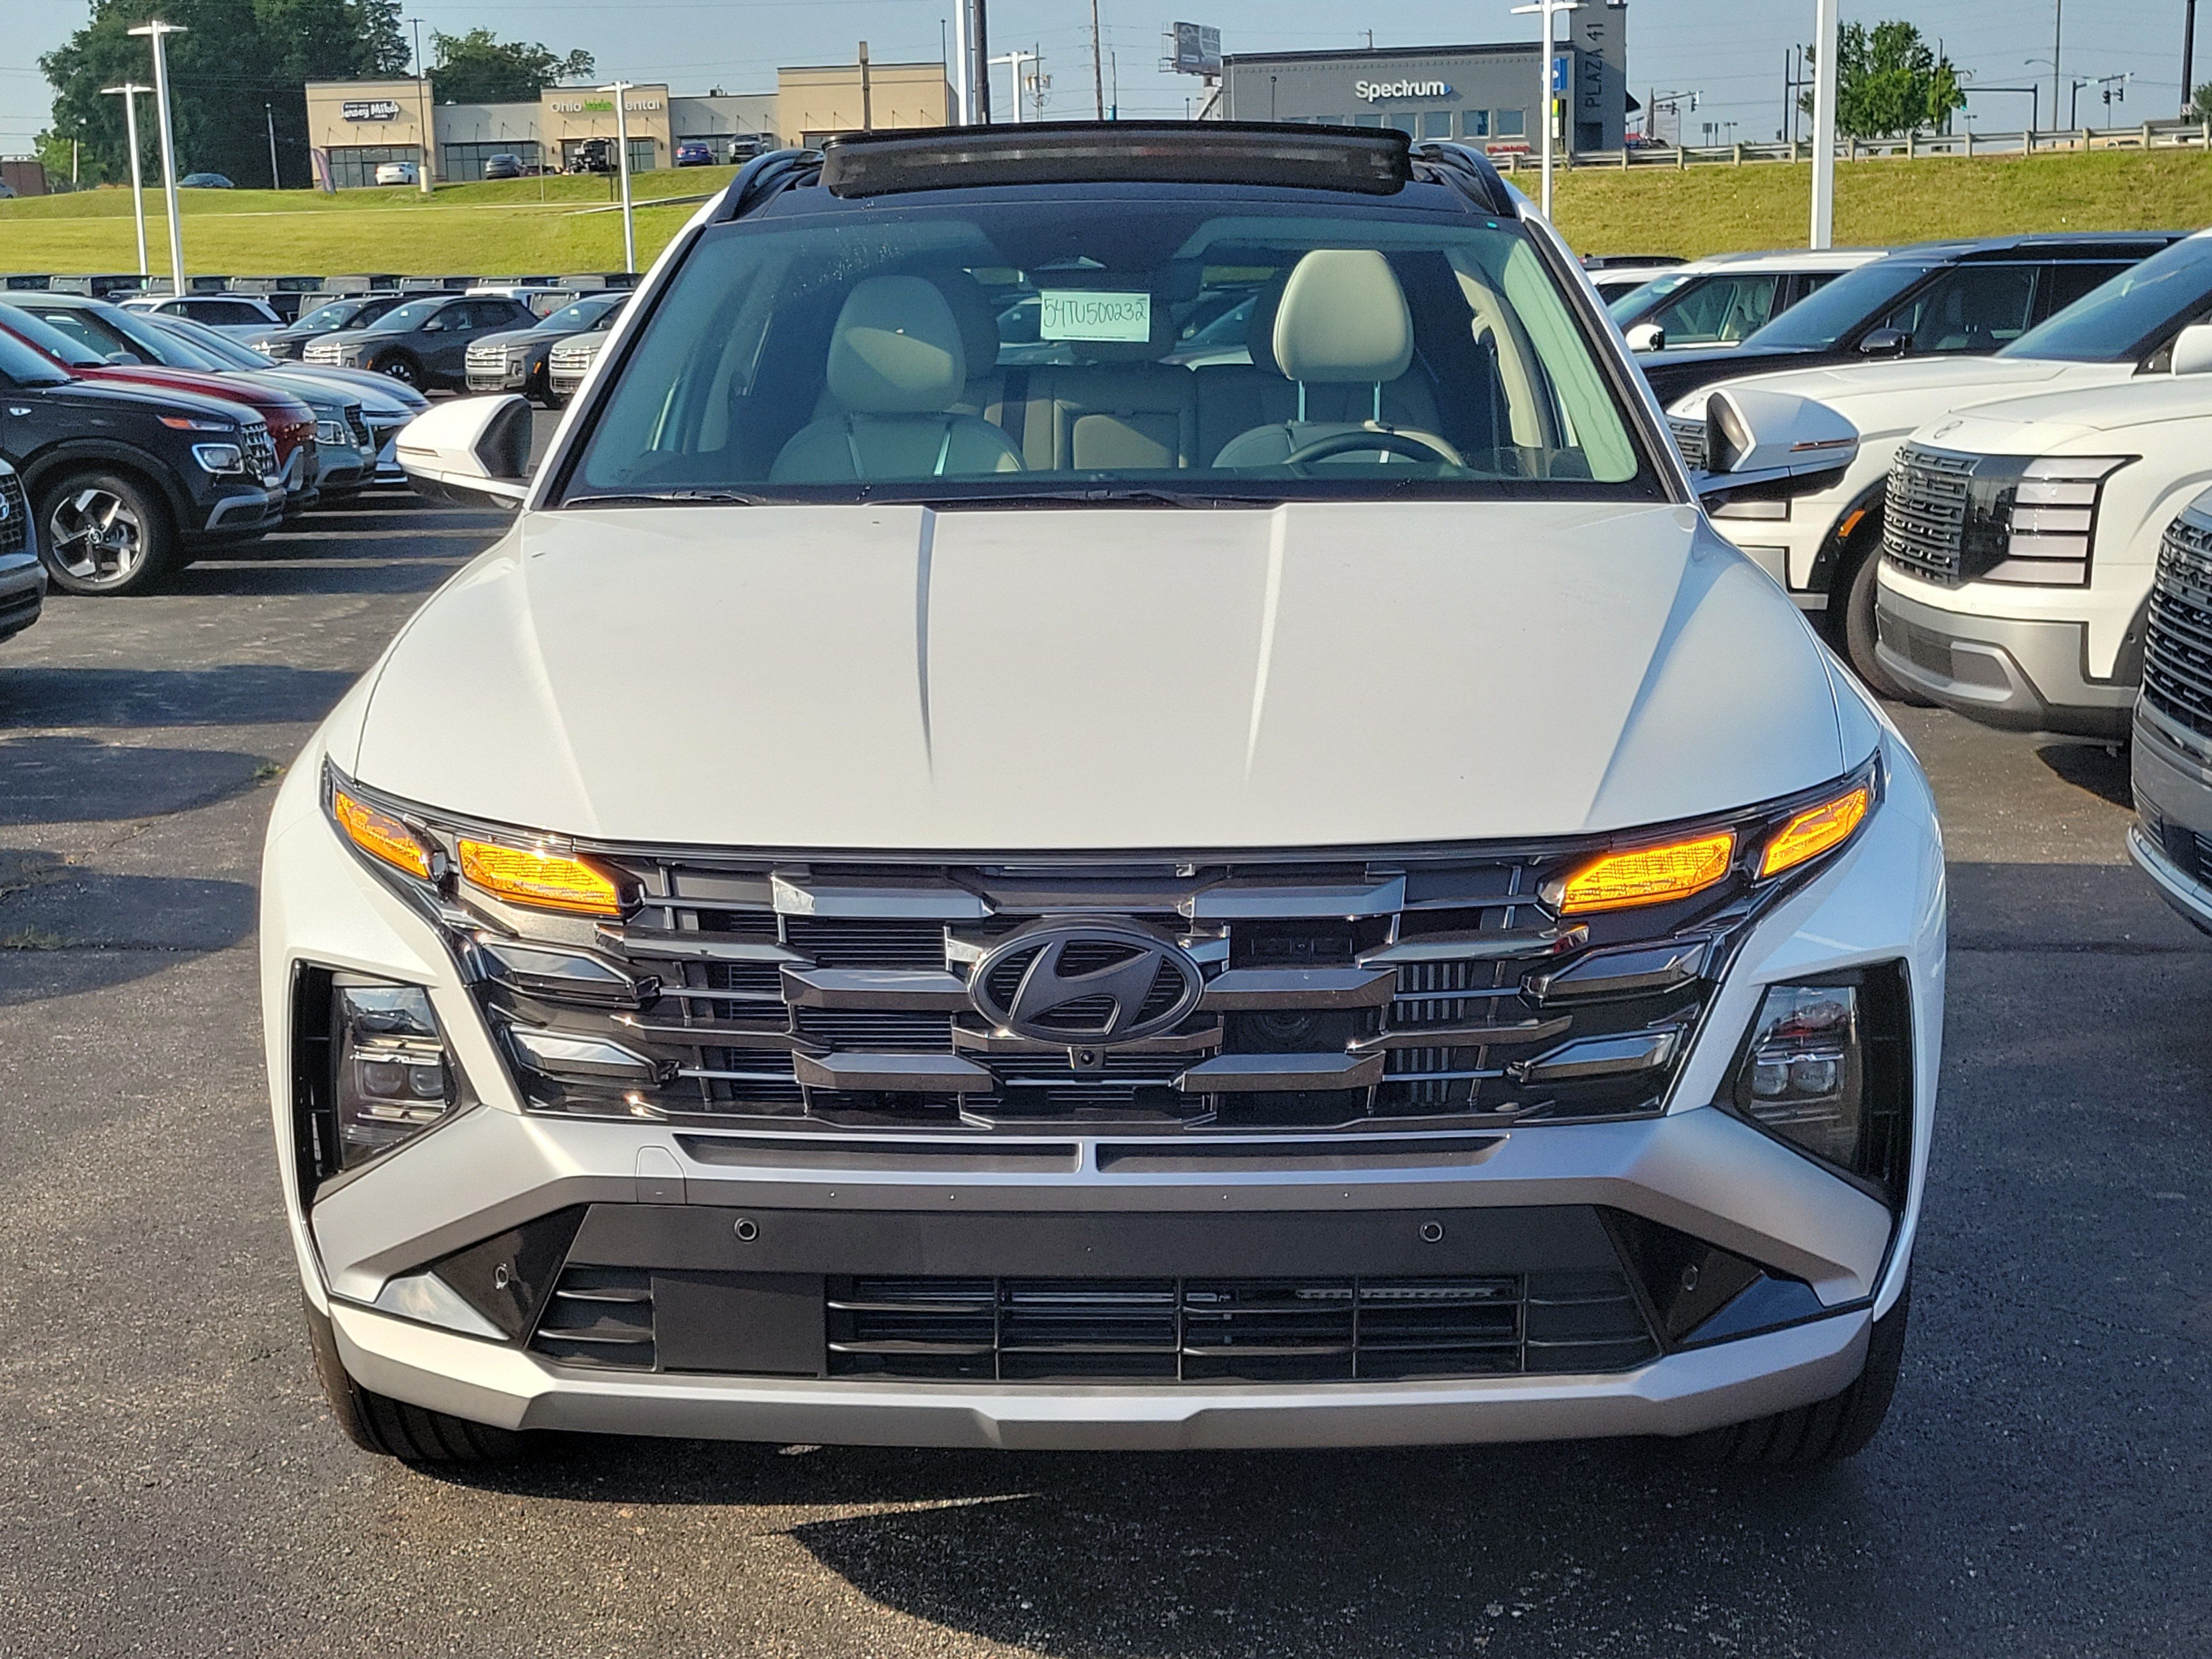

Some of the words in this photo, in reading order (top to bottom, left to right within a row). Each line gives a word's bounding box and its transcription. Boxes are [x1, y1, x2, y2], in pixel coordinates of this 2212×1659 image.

[1586, 23, 1604, 41] 41
[1584, 48, 1605, 108] PLAZA
[1355, 79, 1444, 103] Spectrum
[550, 101, 582, 112] Ohio
[624, 99, 661, 111] ental
[1043, 297, 1147, 328] 54TU500232
